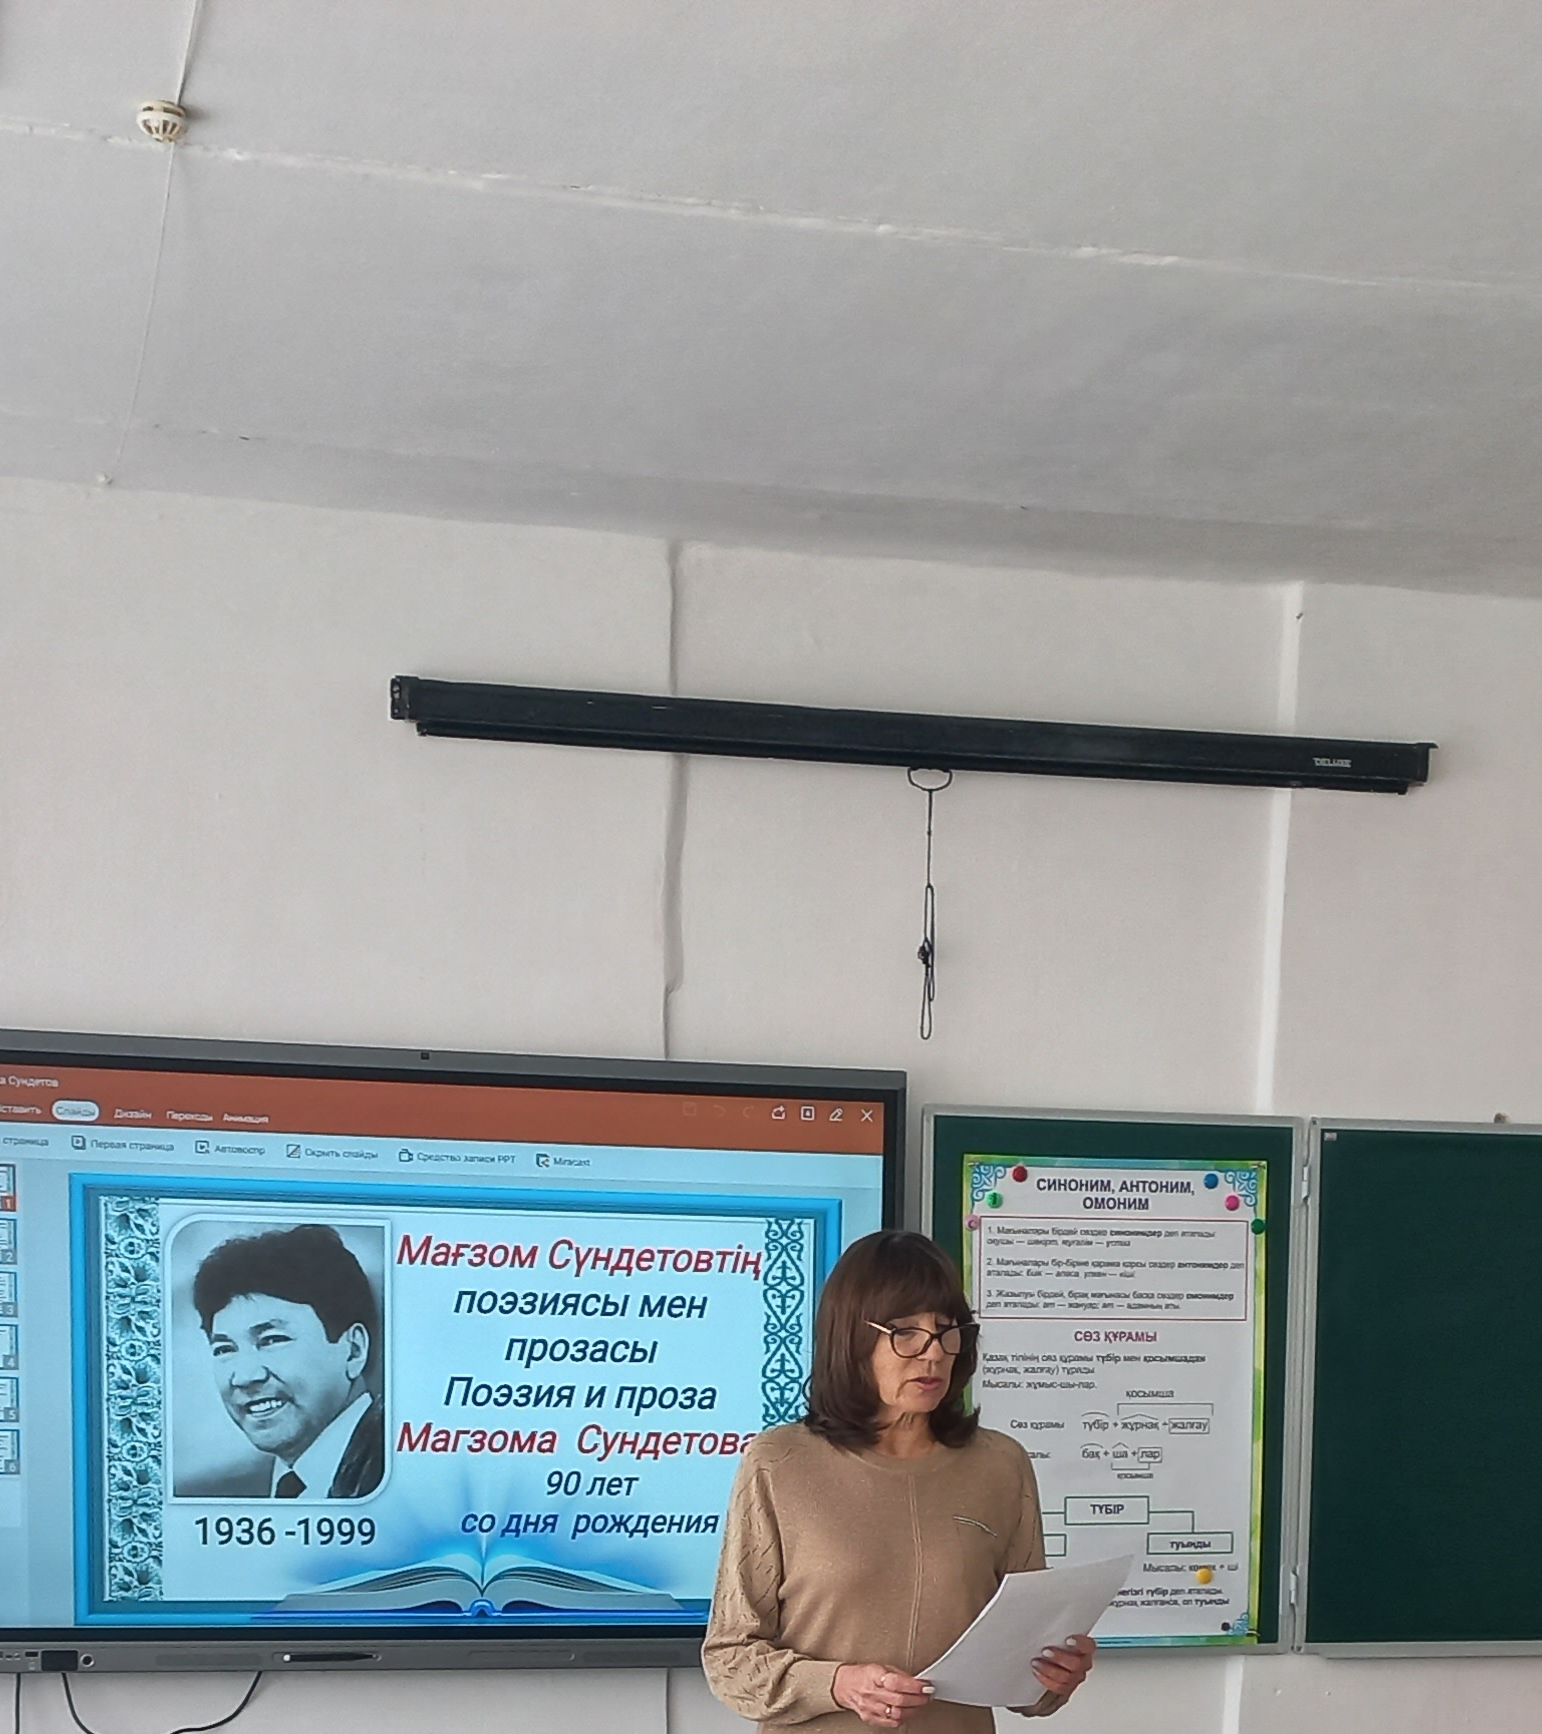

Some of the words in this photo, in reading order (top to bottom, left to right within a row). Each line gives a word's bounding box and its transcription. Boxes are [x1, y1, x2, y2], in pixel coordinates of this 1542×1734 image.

[8, 1075, 59, 1088] Сундетов
[2, 1137, 49, 1148] страница
[91, 1139, 127, 1151] Первая
[129, 1142, 175, 1153] страница
[1036, 1178, 1116, 1194] СИНОНИМ,
[1118, 1179, 1196, 1196] АНТОНИМ,
[1082, 1196, 1150, 1211] ОМОНИМ
[396, 1234, 538, 1269] Мағзом
[548, 1239, 763, 1280] Сүндетовтің
[453, 1290, 630, 1318] поэзиясы
[638, 1294, 709, 1319] мен
[1073, 1330, 1101, 1342] СӨЗ
[1104, 1330, 1158, 1344] ҚҰРАМЫ
[504, 1337, 659, 1369] прозасы
[443, 1376, 576, 1408] Поэзия
[584, 1385, 607, 1409] и
[614, 1386, 719, 1417] проза
[396, 1421, 559, 1454] Магзома
[545, 1471, 581, 1496] 90
[586, 1475, 640, 1497] лет
[1089, 1503, 1125, 1515] ТҮБІР
[194, 1517, 277, 1546] 1936
[283, 1517, 377, 1546] -1999
[460, 1513, 497, 1534] со
[500, 1513, 560, 1538] дня
[570, 1514, 720, 1541] рождения
